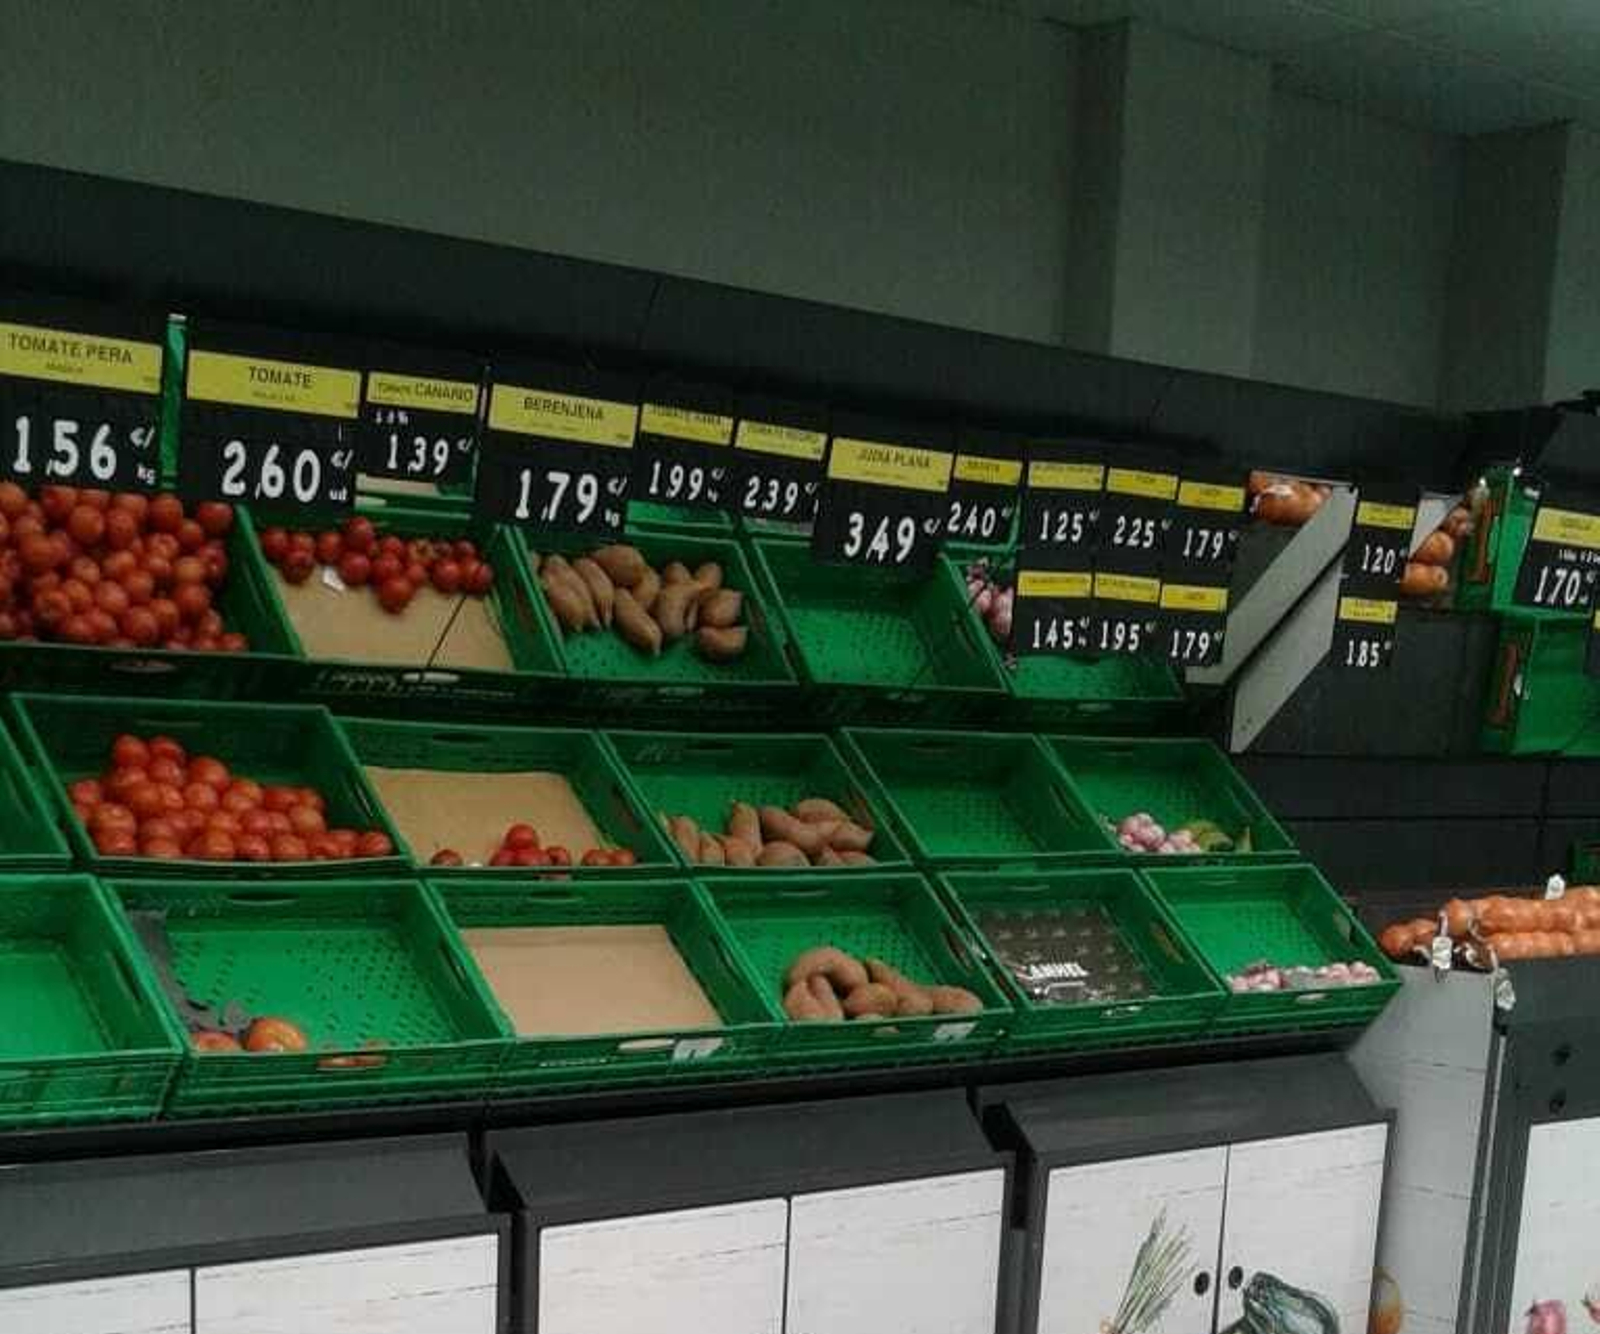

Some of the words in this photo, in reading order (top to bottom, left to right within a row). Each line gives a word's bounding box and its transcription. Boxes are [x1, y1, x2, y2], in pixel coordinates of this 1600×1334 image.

[8, 332, 83, 358] TOMATE
[87, 343, 133, 364] PERA
[248, 365, 313, 389] TOMATE
[524, 397, 604, 420] BERENJENA
